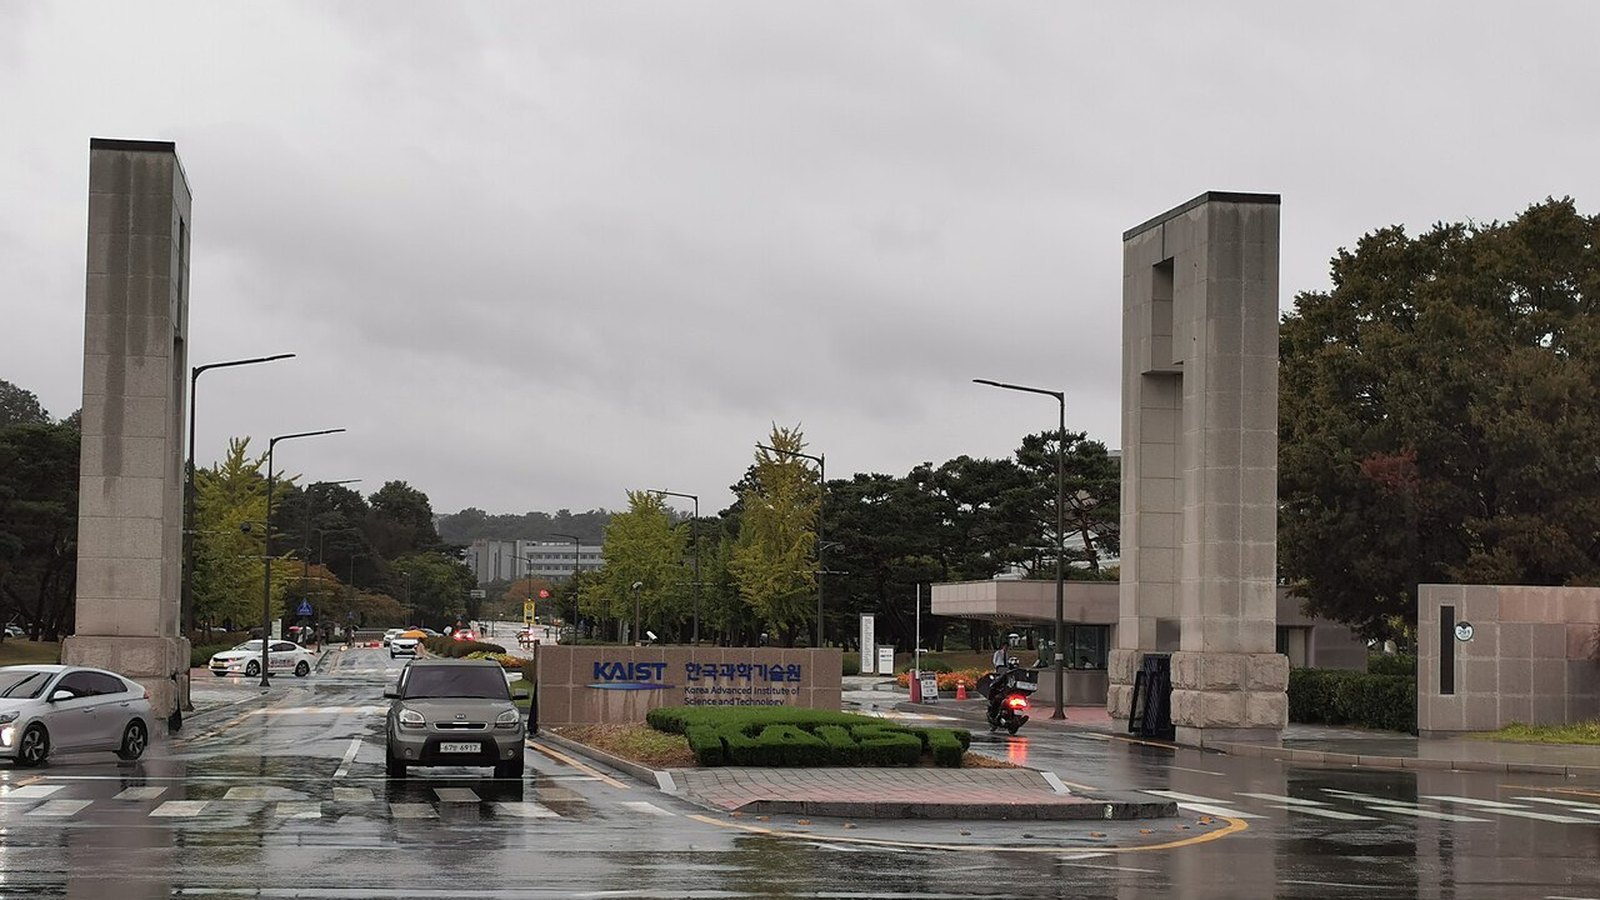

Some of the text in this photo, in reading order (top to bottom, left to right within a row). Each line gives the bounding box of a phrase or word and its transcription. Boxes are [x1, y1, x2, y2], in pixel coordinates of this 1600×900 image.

[593, 661, 668, 681] KAIST
[685, 662, 801, 682] 한국과학기술원
[684, 687, 800, 695] Korea Advanced Institute of
[684, 697, 785, 707] Science and Technology
